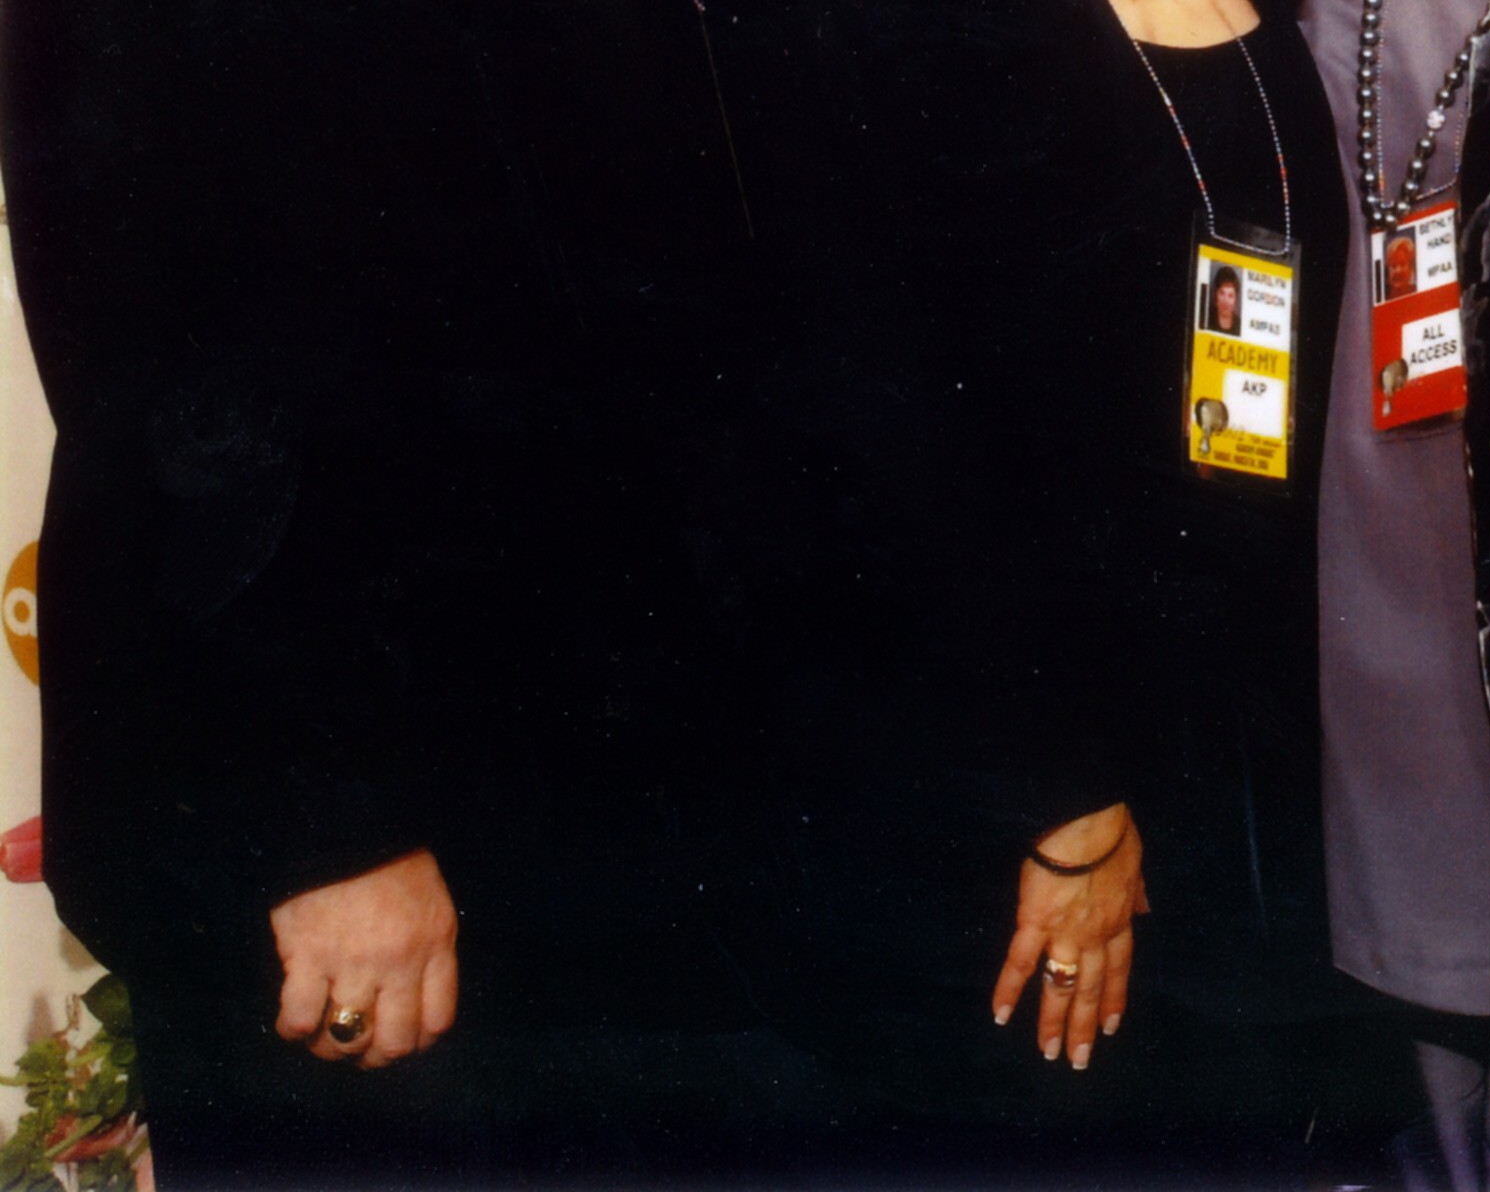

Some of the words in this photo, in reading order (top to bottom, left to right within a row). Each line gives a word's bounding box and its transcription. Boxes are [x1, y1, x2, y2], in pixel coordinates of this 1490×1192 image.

[1247, 271, 1287, 289] MARILYN
[1247, 289, 1286, 307] GORDON
[1423, 324, 1445, 341] ALL
[1206, 340, 1278, 374] ACADEMY
[1410, 339, 1457, 364] ACCESS
[1242, 380, 1268, 396] AKP
